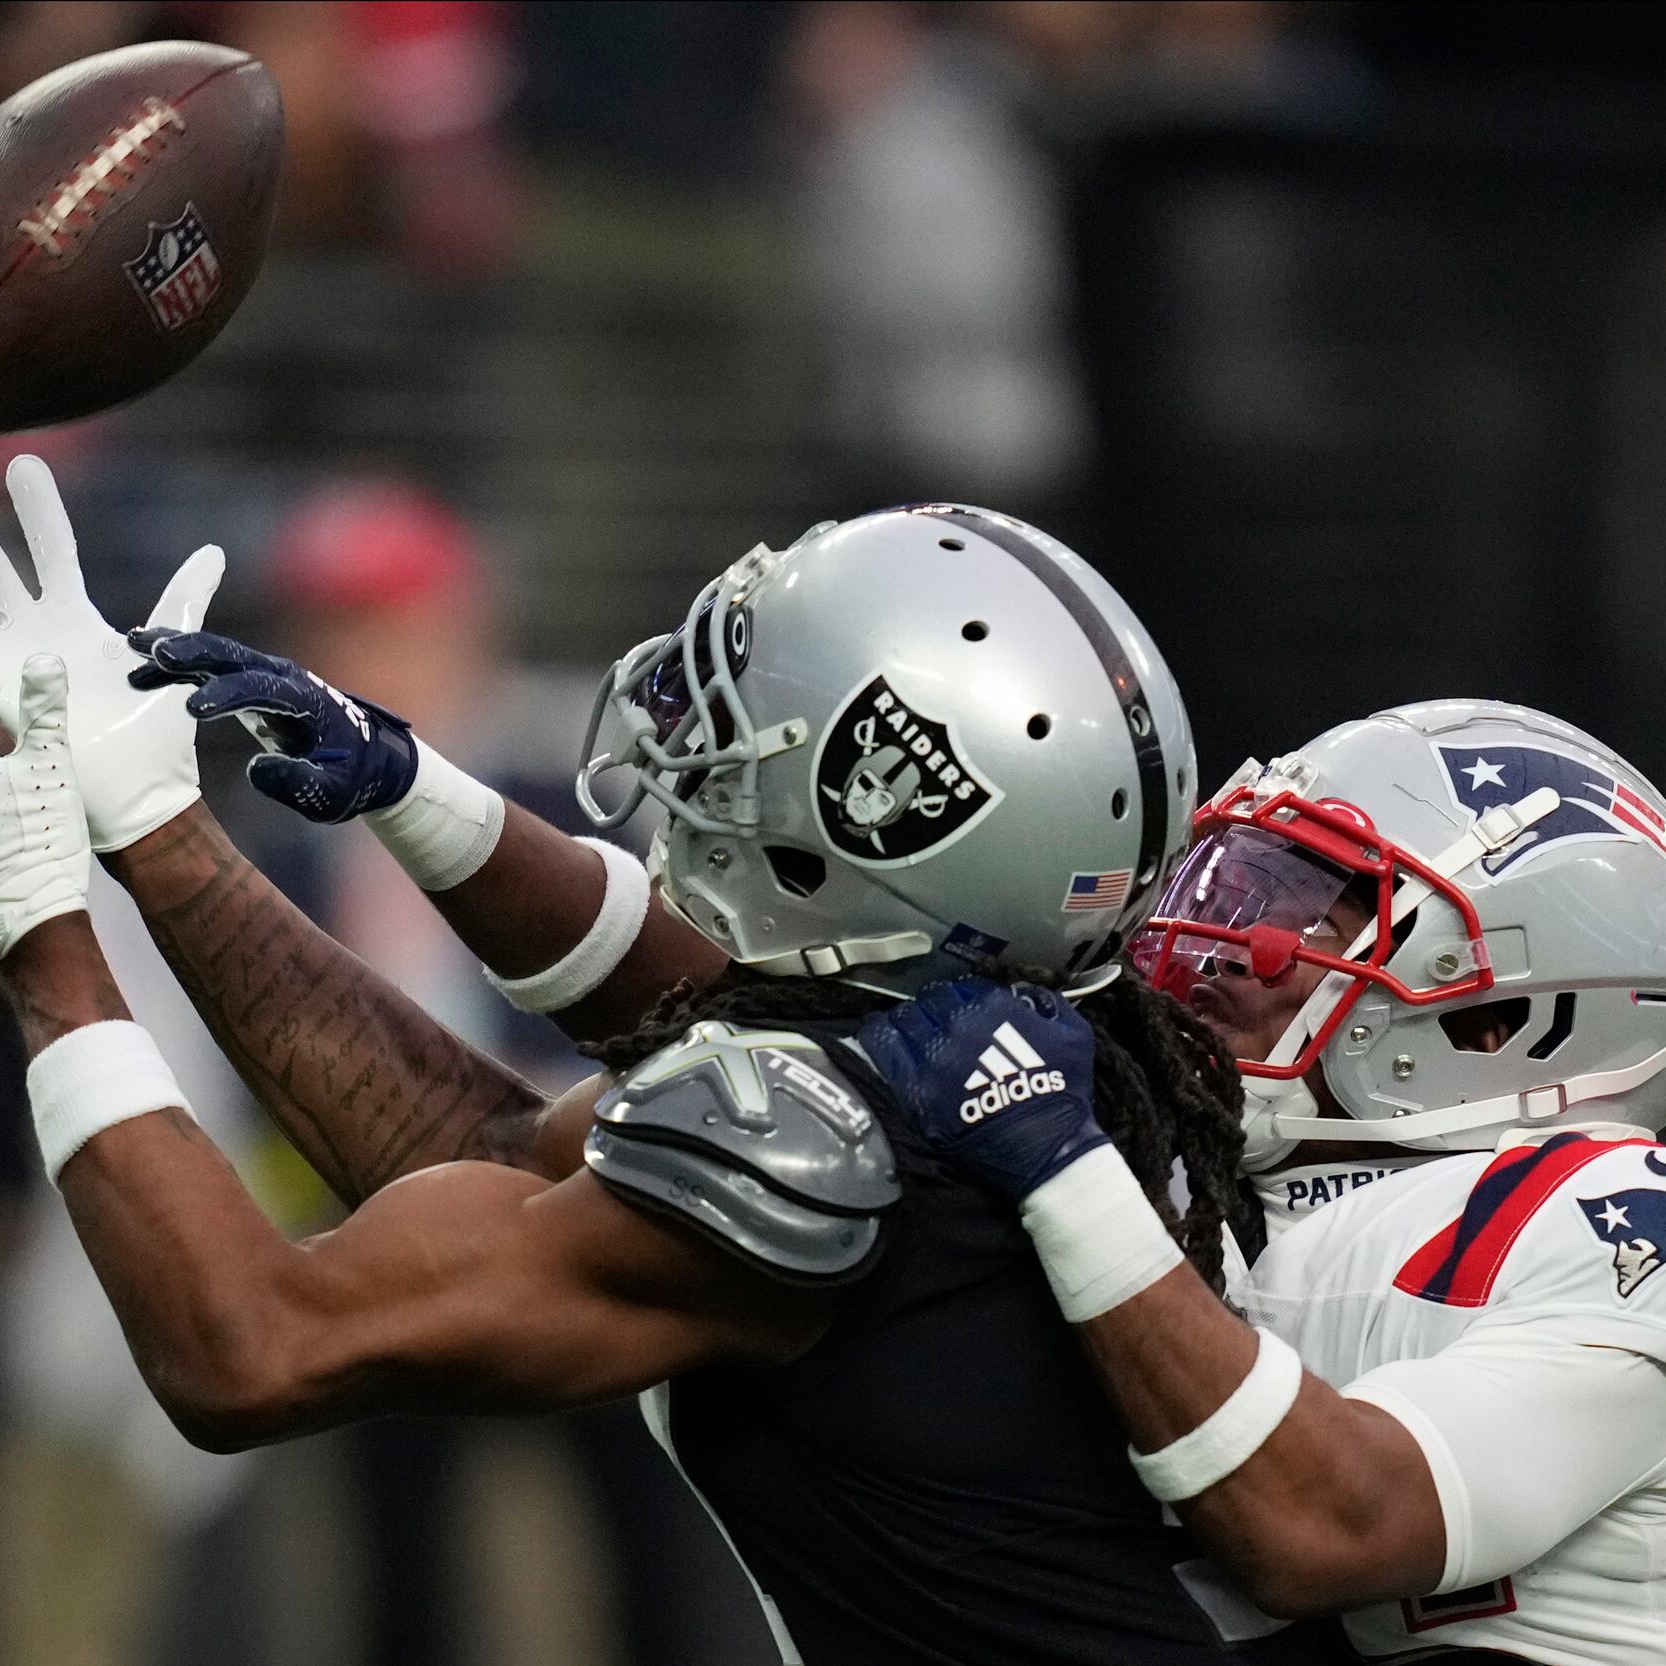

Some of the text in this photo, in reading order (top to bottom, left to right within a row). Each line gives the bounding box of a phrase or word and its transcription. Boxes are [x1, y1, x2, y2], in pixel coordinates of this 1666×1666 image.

[155, 254, 222, 323] NFL
[874, 691, 976, 800] RAIDERS
[959, 1070, 1066, 1124] adidas
